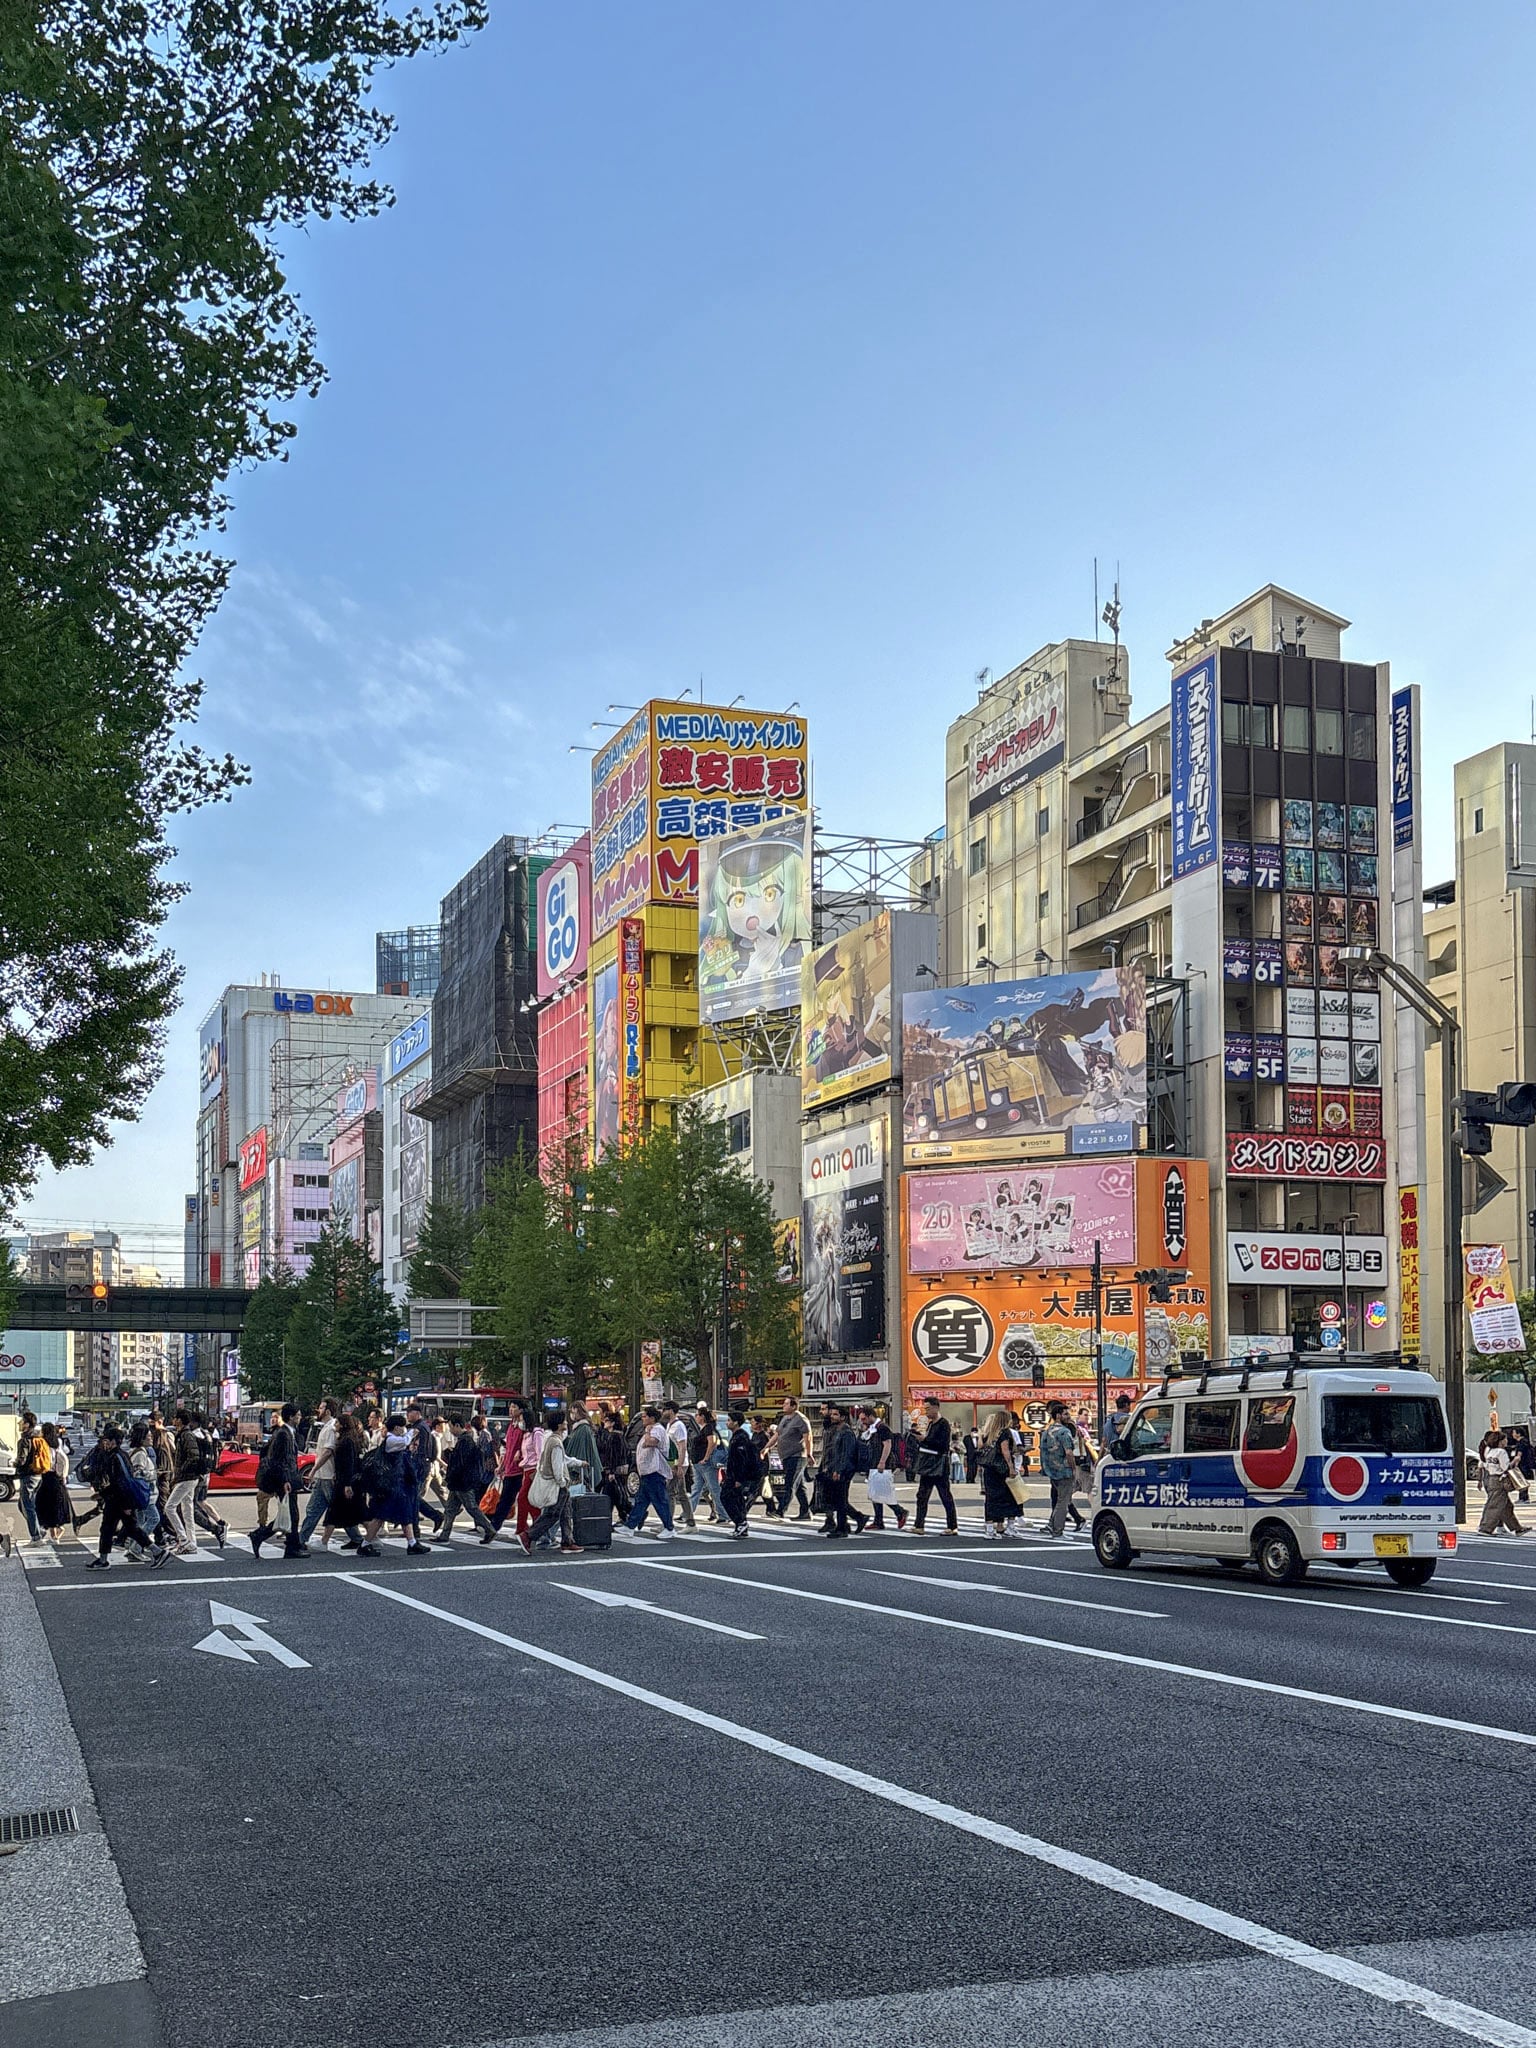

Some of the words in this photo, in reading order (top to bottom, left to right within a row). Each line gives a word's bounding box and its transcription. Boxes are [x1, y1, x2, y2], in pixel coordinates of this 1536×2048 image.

[657, 714, 804, 749] MEDIAリサイクル
[976, 706, 1057, 785] メイドカジノ
[1188, 668, 1212, 850] アメニティードリーム
[658, 747, 804, 797] 激安販売
[1255, 867, 1281, 889] 7F
[1255, 960, 1282, 982] 6F
[1256, 1058, 1283, 1078] 5F
[1290, 1114, 1313, 1124] Stars
[1108, 1134, 1129, 1143] 5.07
[811, 1141, 873, 1179] amiami
[1233, 1138, 1380, 1175] メイドカジノ
[1262, 1249, 1382, 1271] スマホ修理王
[1410, 1254, 1418, 1286] TAX
[1042, 1288, 1133, 1318] 大黒屋
[1324, 1307, 1336, 1316] 40
[1411, 1292, 1420, 1334] FREE
[1000, 1309, 1036, 1321] チケット
[922, 1304, 985, 1367] 質
[827, 1371, 854, 1386] COMIC
[854, 1370, 867, 1385] ZIN
[1379, 1468, 1454, 1484] ナカムラ防災
[1104, 1483, 1189, 1506] ナカムラ防災
[1152, 1521, 1243, 1533] www.nbnbnb.com
[1339, 1513, 1431, 1521] www.nbnbnb.com
